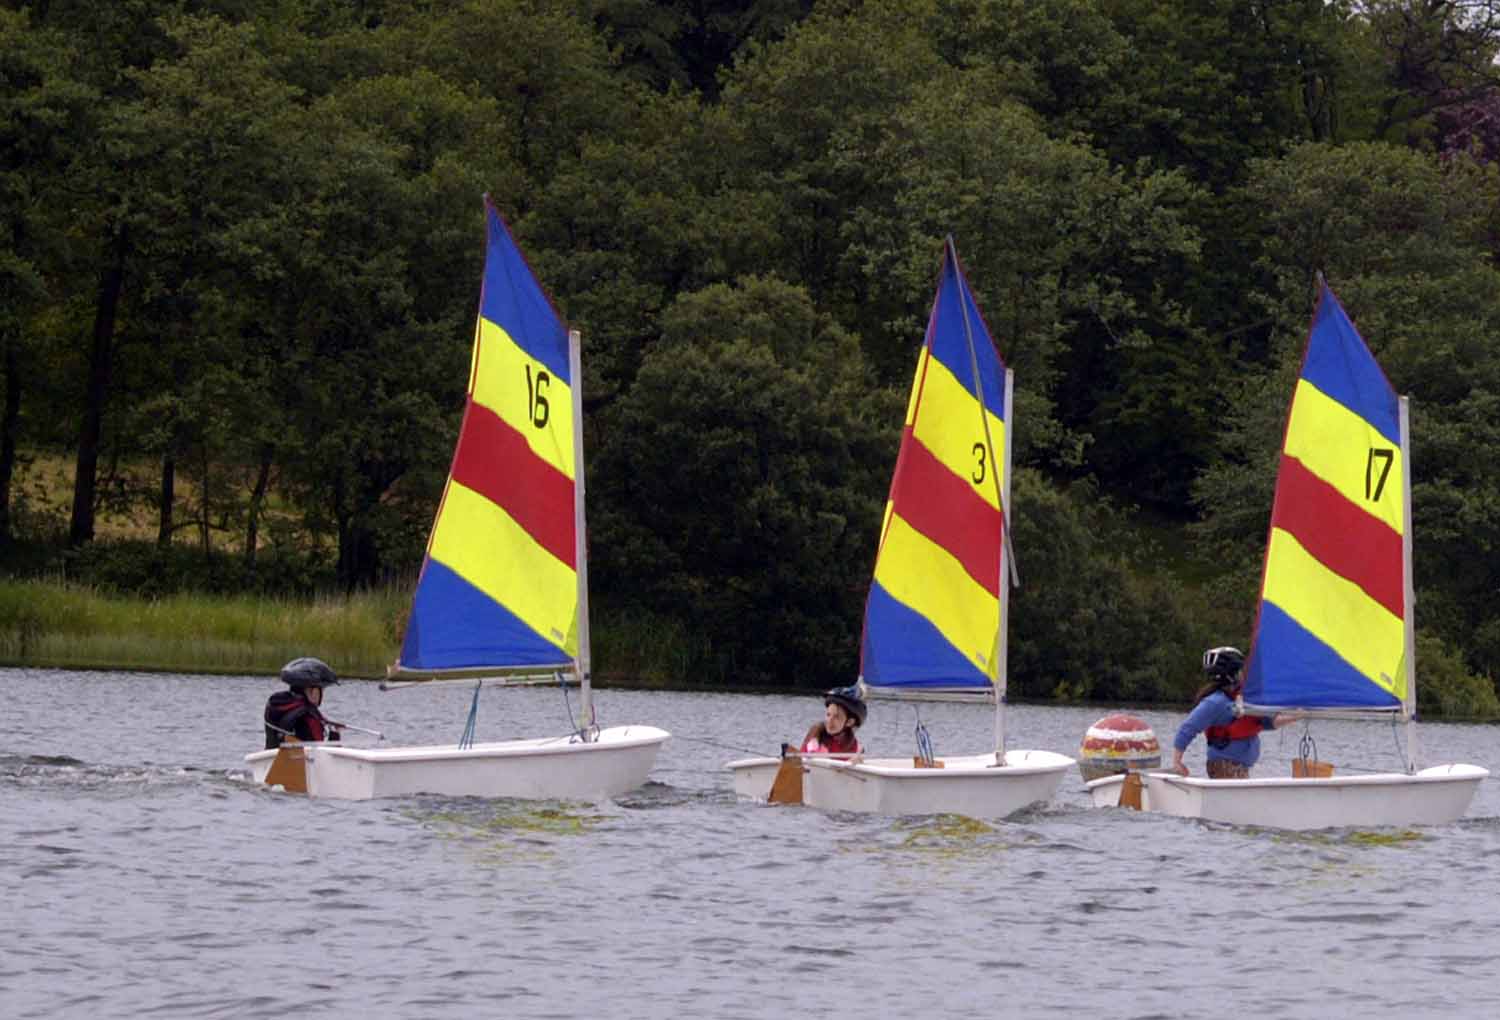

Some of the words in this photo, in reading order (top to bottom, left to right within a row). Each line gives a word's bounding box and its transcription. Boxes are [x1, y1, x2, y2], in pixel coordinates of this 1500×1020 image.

[525, 364, 550, 429] 16
[972, 442, 986, 485] 3
[1365, 447, 1394, 502] 17
